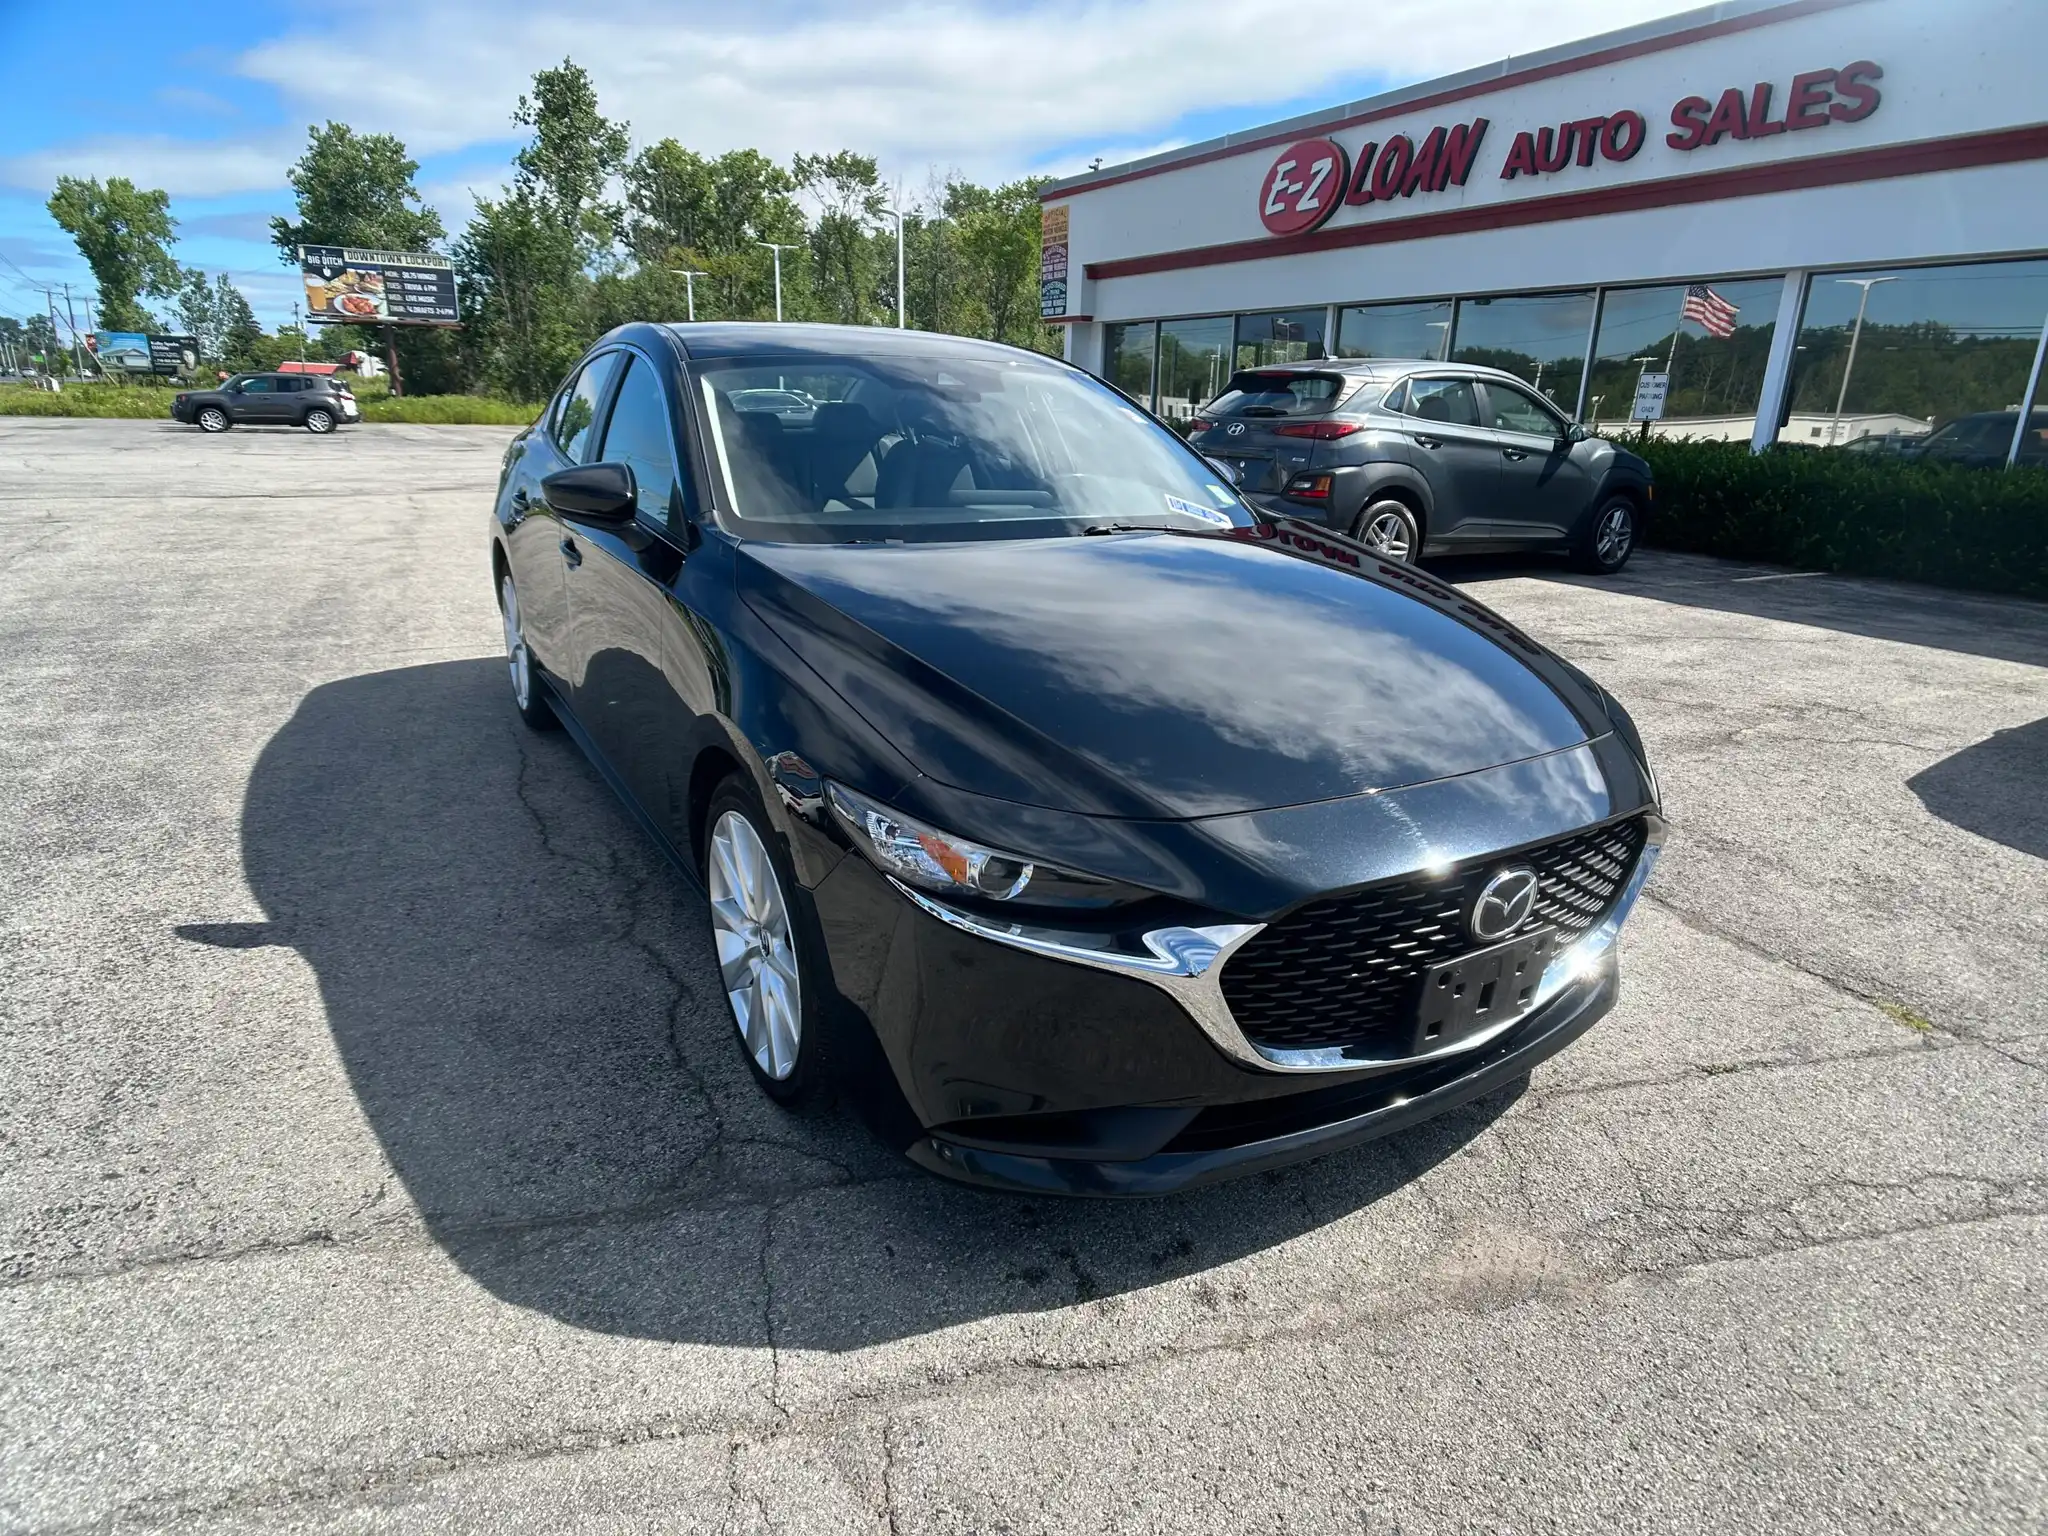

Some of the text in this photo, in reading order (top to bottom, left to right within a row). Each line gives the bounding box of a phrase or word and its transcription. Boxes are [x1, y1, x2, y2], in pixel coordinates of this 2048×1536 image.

[1265, 60, 1883, 216] E-Z LOAN AUTO SALES
[307, 255, 343, 266] BIG DITCH
[347, 251, 449, 268] DOWNTOWN LOCKPORT
